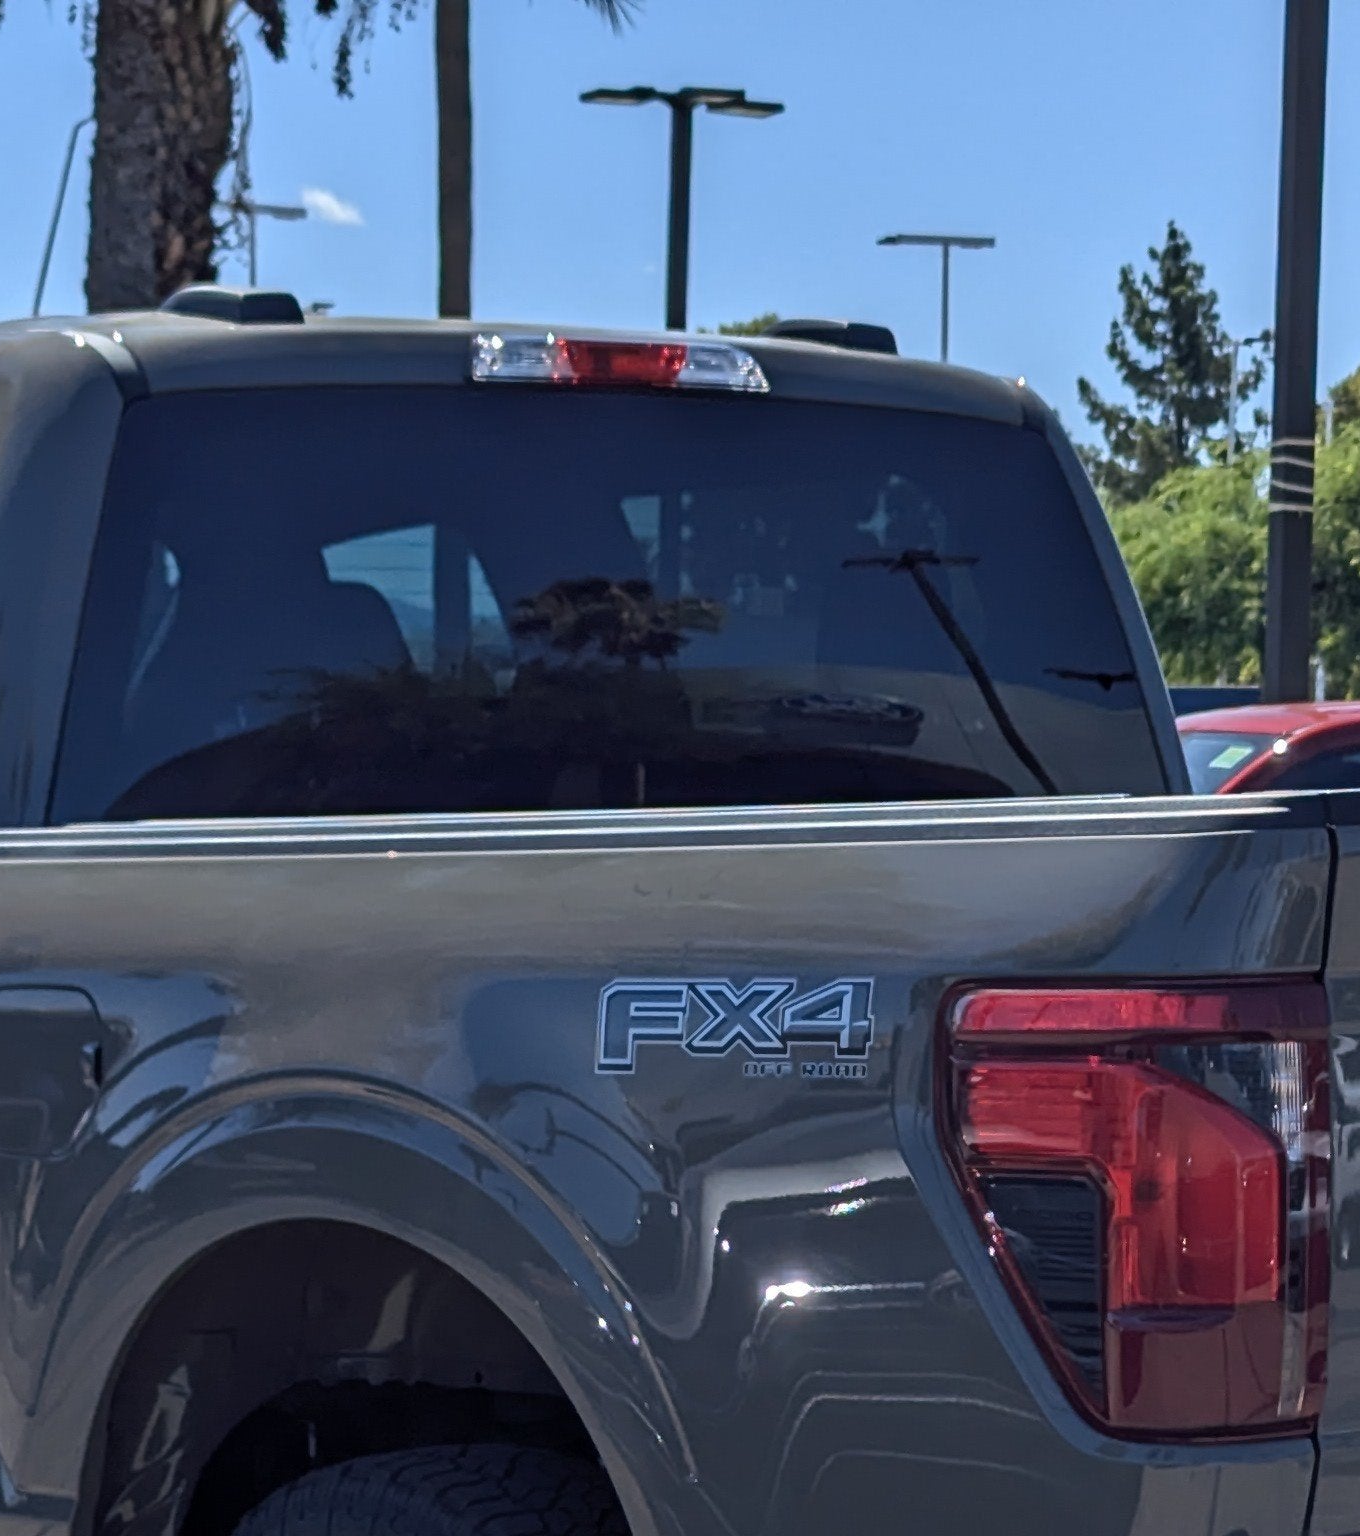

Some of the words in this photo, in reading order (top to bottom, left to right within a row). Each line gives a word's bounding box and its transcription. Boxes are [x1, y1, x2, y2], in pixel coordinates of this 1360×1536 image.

[594, 977, 875, 1075] FX4
[742, 1061, 792, 1078] OFF
[800, 1061, 868, 1079] ROAD
